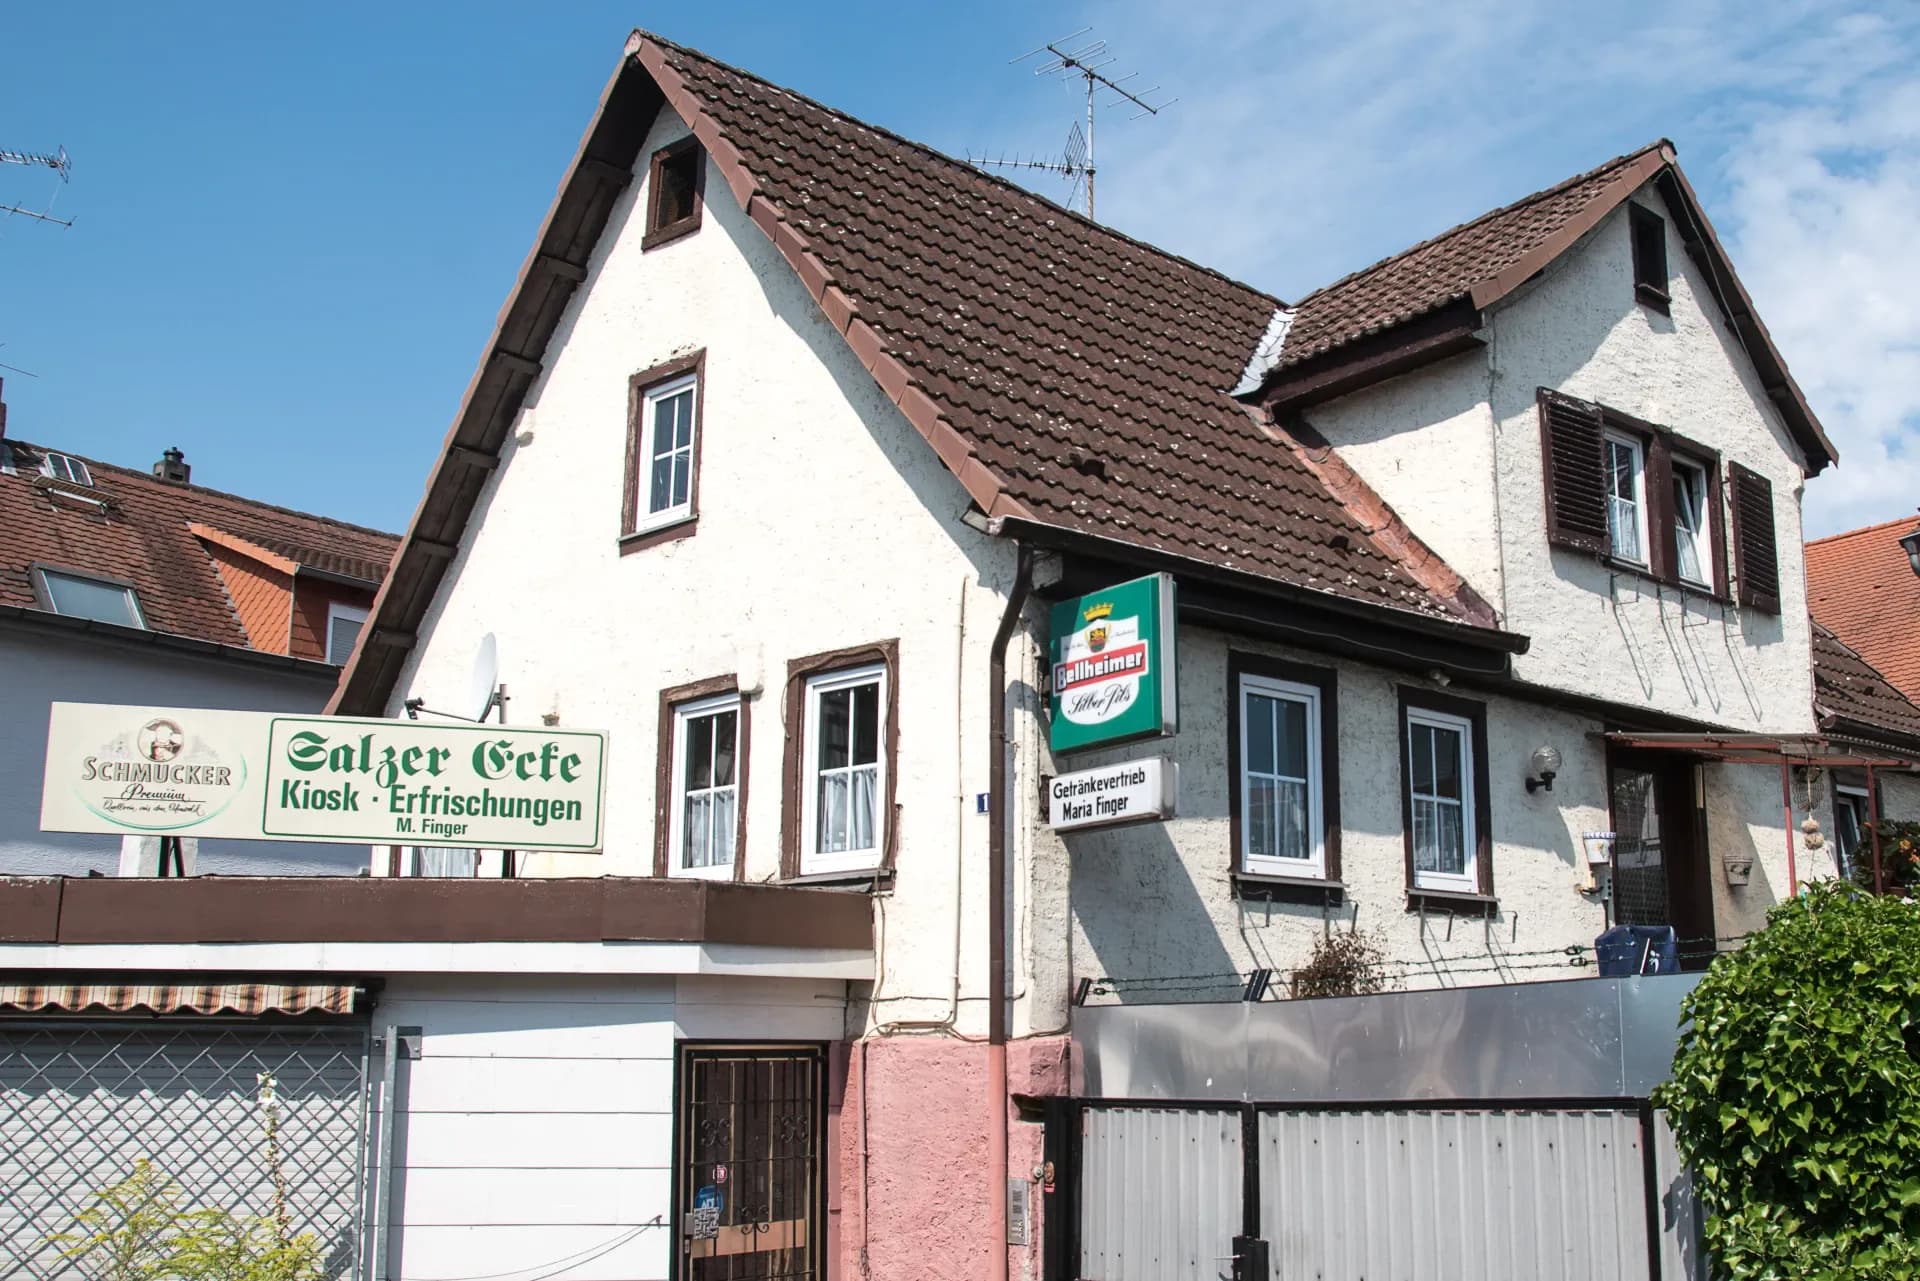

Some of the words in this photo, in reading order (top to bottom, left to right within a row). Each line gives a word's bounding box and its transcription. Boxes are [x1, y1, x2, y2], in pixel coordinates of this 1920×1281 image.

[1057, 651, 1143, 691] Bellheimer
[1068, 689, 1104, 715] Silber
[1098, 683, 1130, 716] Pils
[81, 755, 232, 786] SCHMUCKER
[287, 731, 451, 789] Salzer
[472, 739, 582, 784] Ecke
[120, 783, 186, 801] Premium
[1053, 768, 1146, 799] Getränkevertrieb
[280, 779, 360, 812] Kiosk
[389, 784, 582, 826] Erfrischungen
[1063, 800, 1092, 821] Maria
[1096, 795, 1129, 816] Finger
[396, 817, 416, 834] M.
[422, 818, 468, 838] Finger
